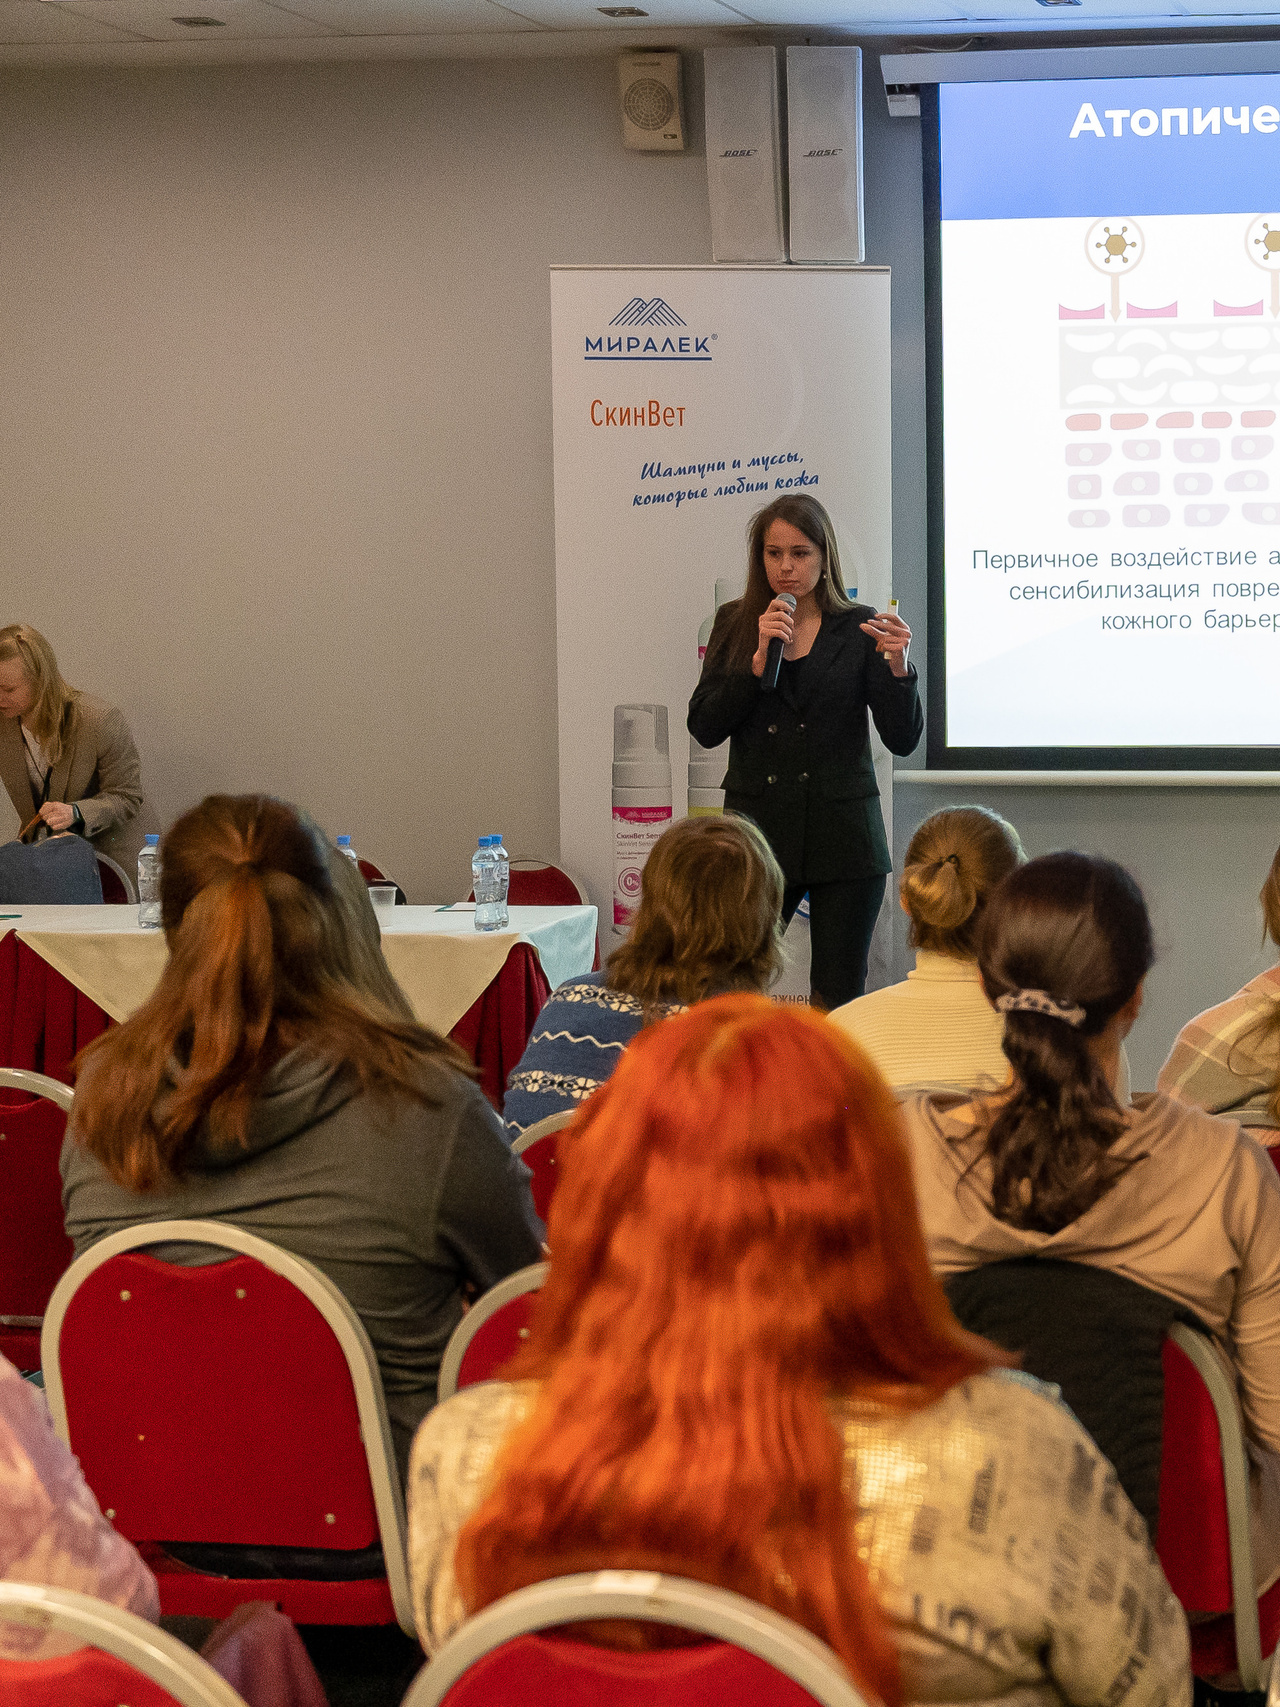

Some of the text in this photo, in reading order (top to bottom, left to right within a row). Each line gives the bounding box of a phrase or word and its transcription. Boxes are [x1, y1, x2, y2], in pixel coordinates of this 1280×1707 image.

[590, 399, 686, 427] СкинВет
[640, 451, 804, 481] Шампуни и муссы,
[632, 470, 820, 508] которые любит кожа
[972, 549, 1099, 574] Первичное
[1110, 547, 1257, 570] воздействие
[1009, 579, 1200, 602] сенсибилизация
[1101, 613, 1192, 632] кожного
